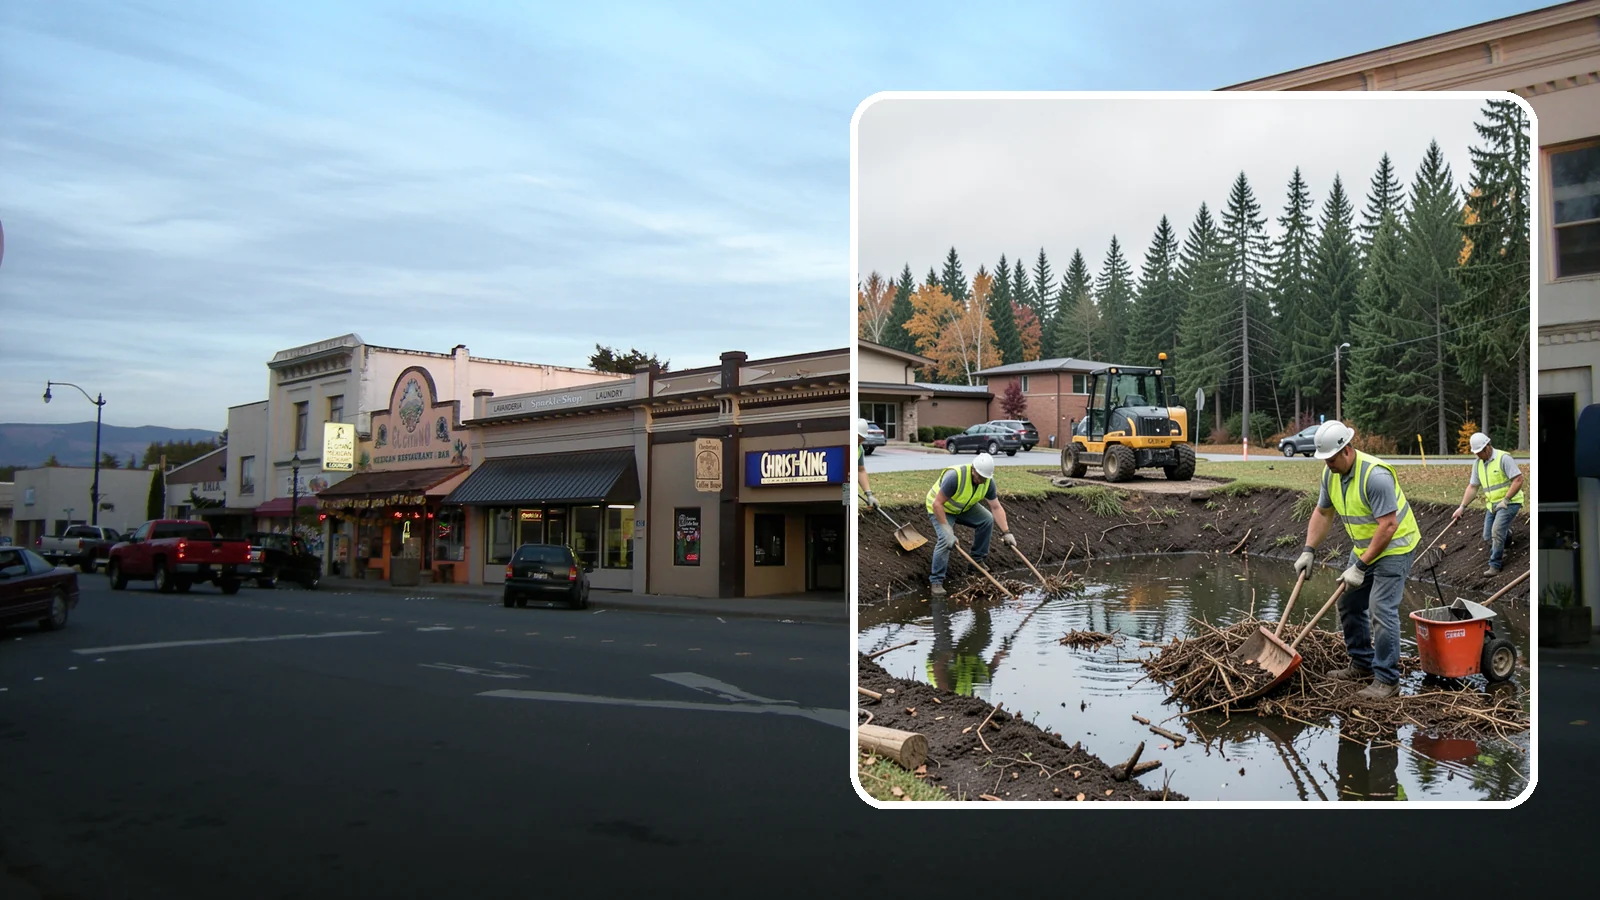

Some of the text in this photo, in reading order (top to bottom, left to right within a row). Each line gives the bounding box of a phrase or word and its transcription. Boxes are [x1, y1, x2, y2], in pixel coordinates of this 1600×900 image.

[494, 389, 623, 412] LAVANDERIA Sparkle Shop LAUNDRY
[392, 426, 402, 449] EL
[373, 455, 396, 464] MEXICAN
[397, 451, 433, 463] RESTAURANT
[438, 450, 450, 459] BAR
[761, 450, 827, 478] CHRIST KING
